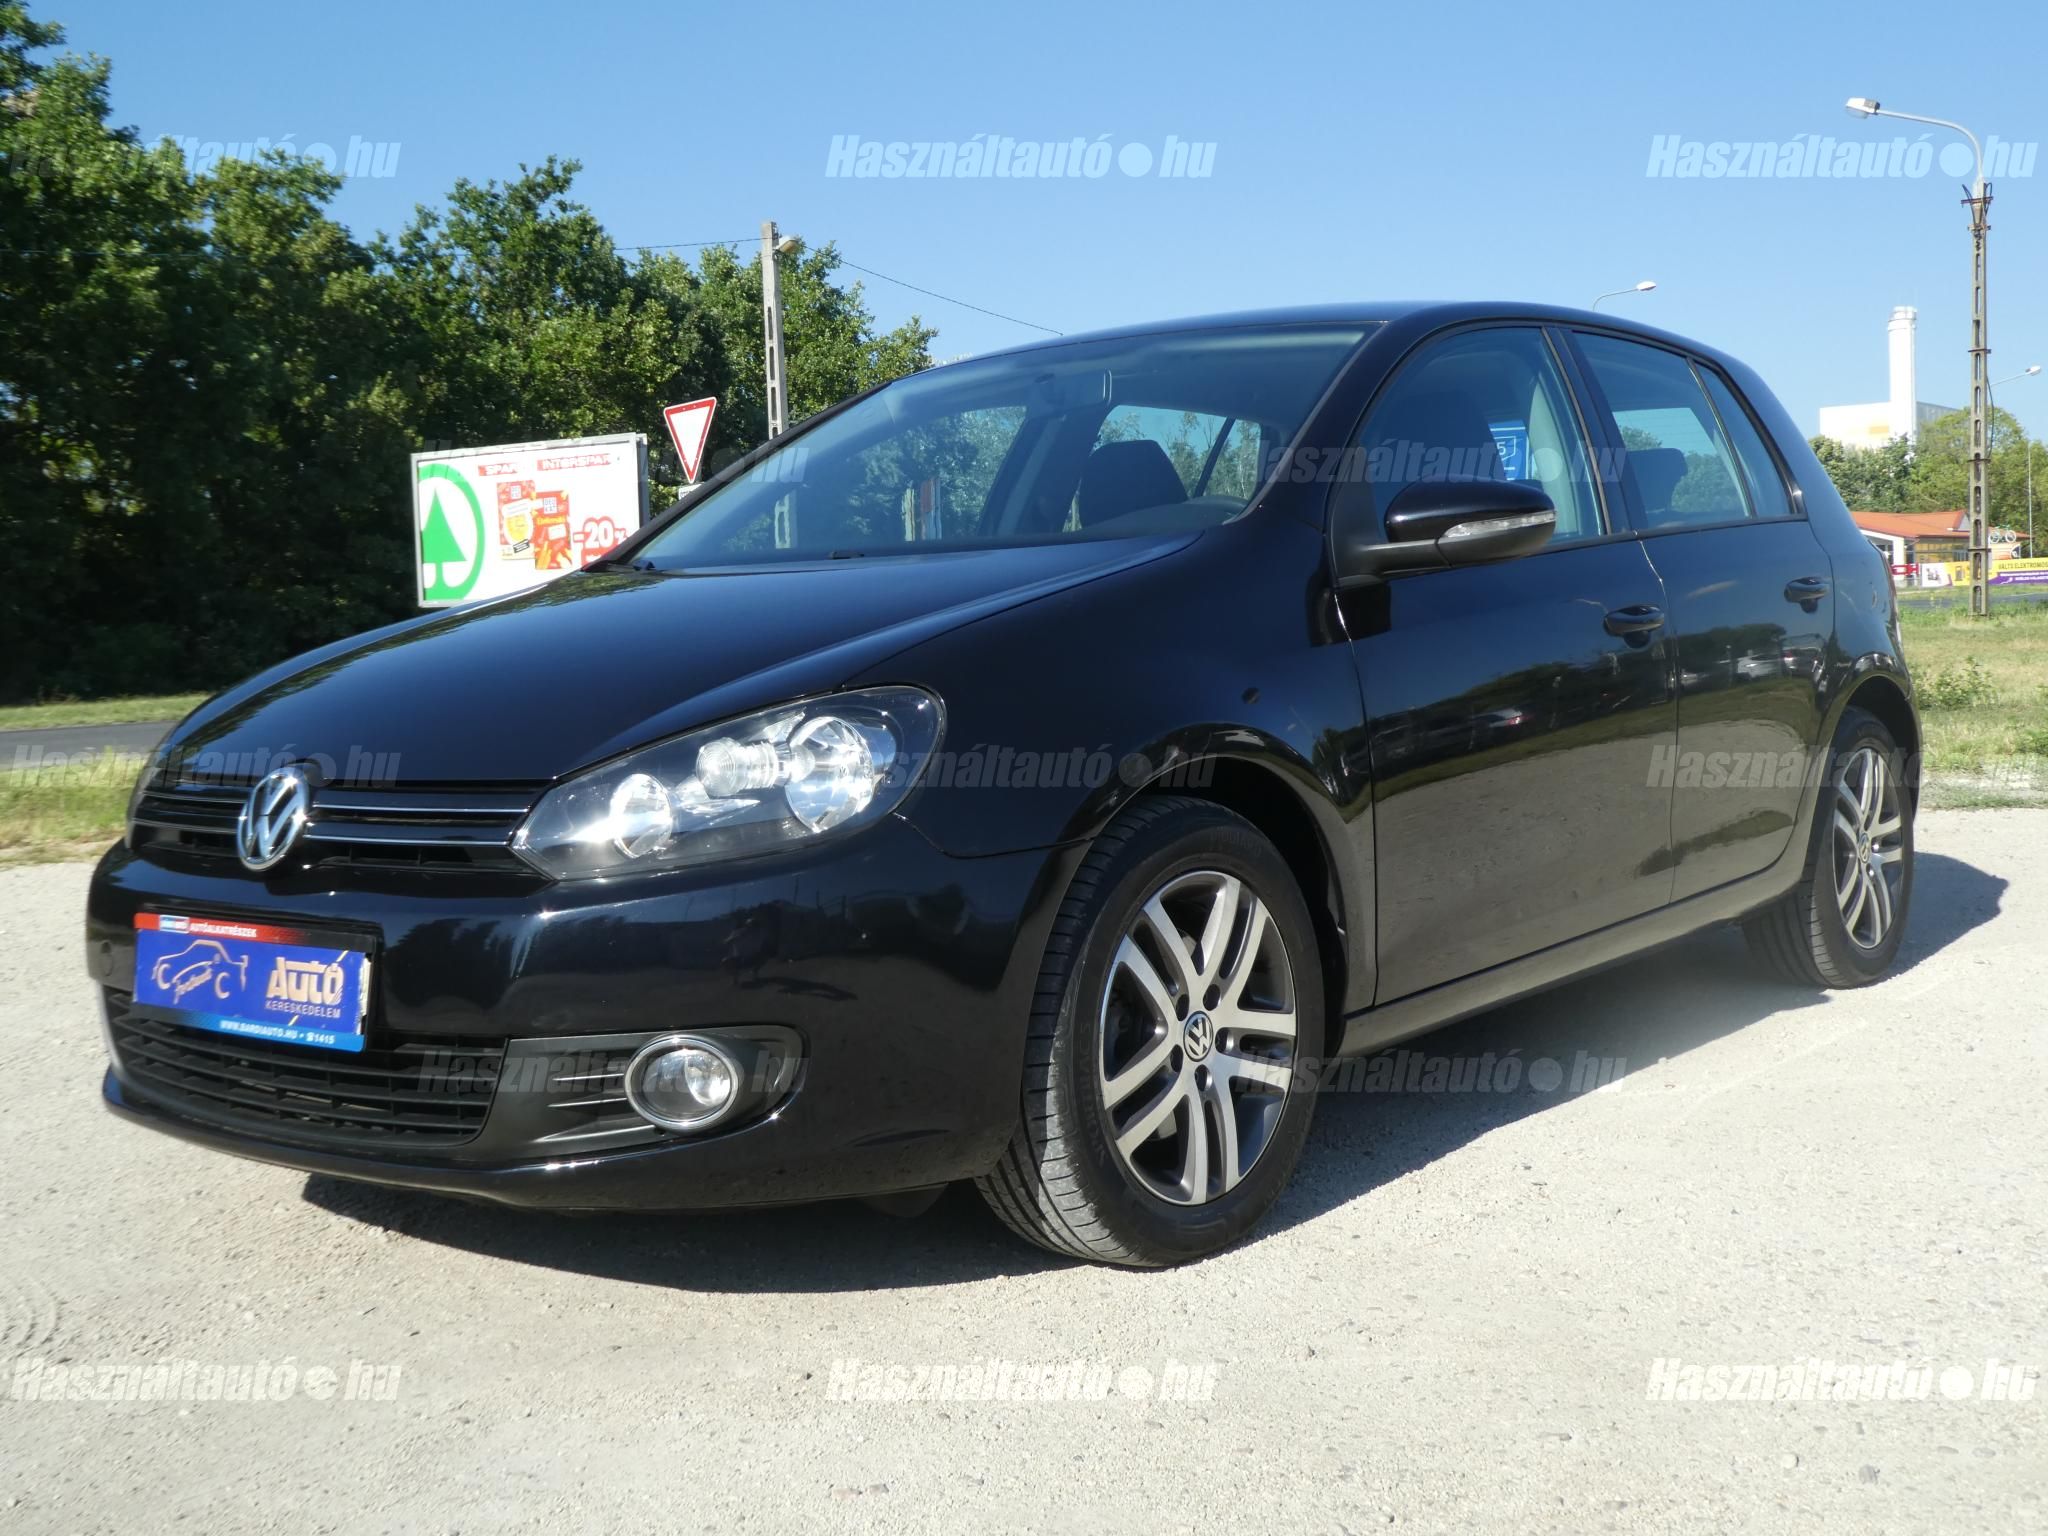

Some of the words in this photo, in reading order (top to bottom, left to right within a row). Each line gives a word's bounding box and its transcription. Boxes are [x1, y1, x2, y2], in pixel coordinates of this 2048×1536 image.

[485, 463, 519, 474] SPAR
[542, 453, 612, 469] INTERSPAR
[265, 1000, 341, 1018] KERESKEDELEM
